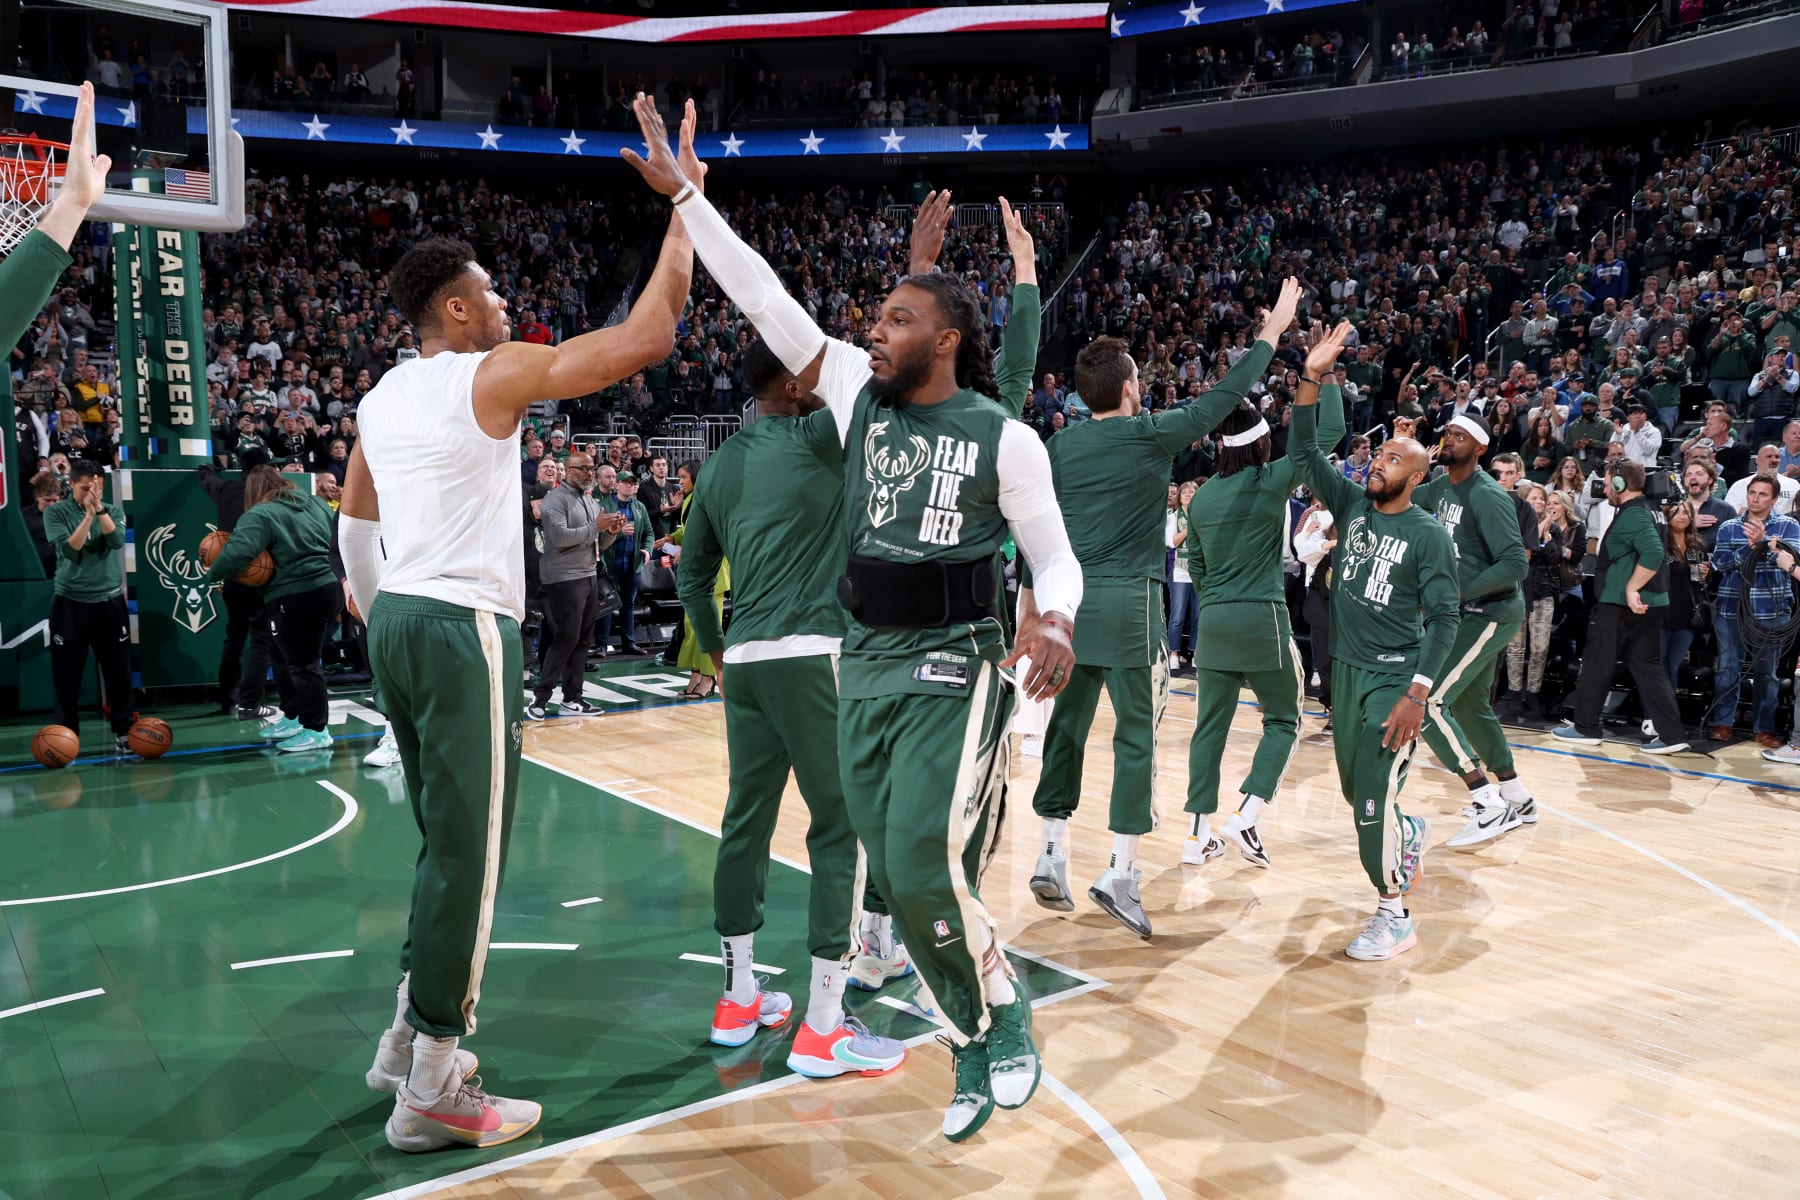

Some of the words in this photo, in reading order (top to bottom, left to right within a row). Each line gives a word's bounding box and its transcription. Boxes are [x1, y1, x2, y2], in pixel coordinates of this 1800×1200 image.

[157, 230, 184, 297] EAR
[165, 301, 181, 336] THE
[165, 340, 194, 426] DEER
[933, 435, 979, 477] FEAR
[931, 469, 964, 511] THE
[918, 506, 963, 546] DEER
[1446, 503, 1464, 525] FEAR
[904, 548, 924, 557] BUCKS
[1375, 534, 1408, 565] FEAR
[1371, 556, 1394, 583] THE
[1364, 576, 1394, 607] DEER
